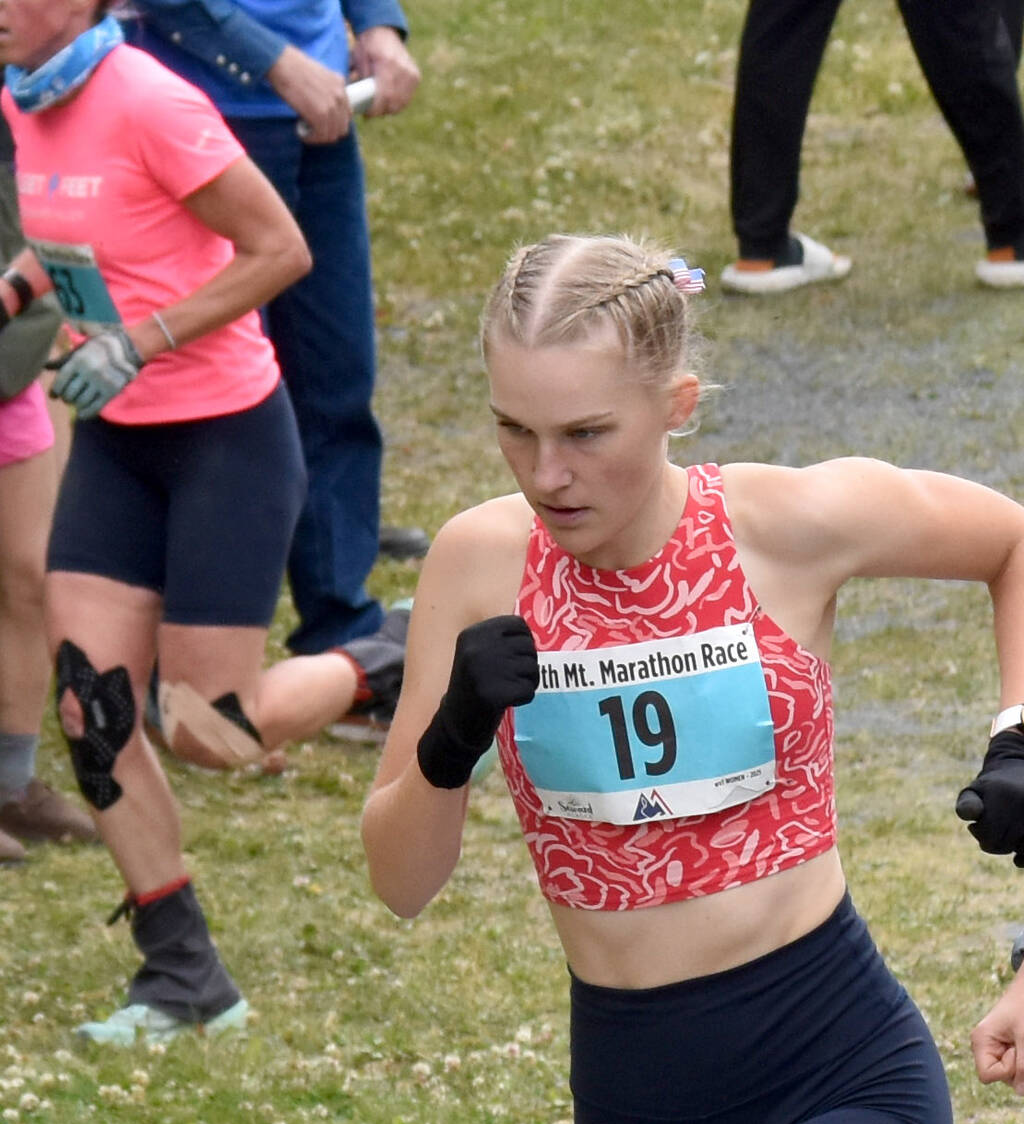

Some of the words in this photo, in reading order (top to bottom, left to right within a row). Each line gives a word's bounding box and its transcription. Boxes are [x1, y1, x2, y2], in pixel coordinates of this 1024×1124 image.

[537, 663, 560, 689] th
[563, 662, 595, 688] Mt.
[599, 651, 698, 685] Marathon
[700, 641, 748, 669] Race
[598, 690, 678, 781] 19
